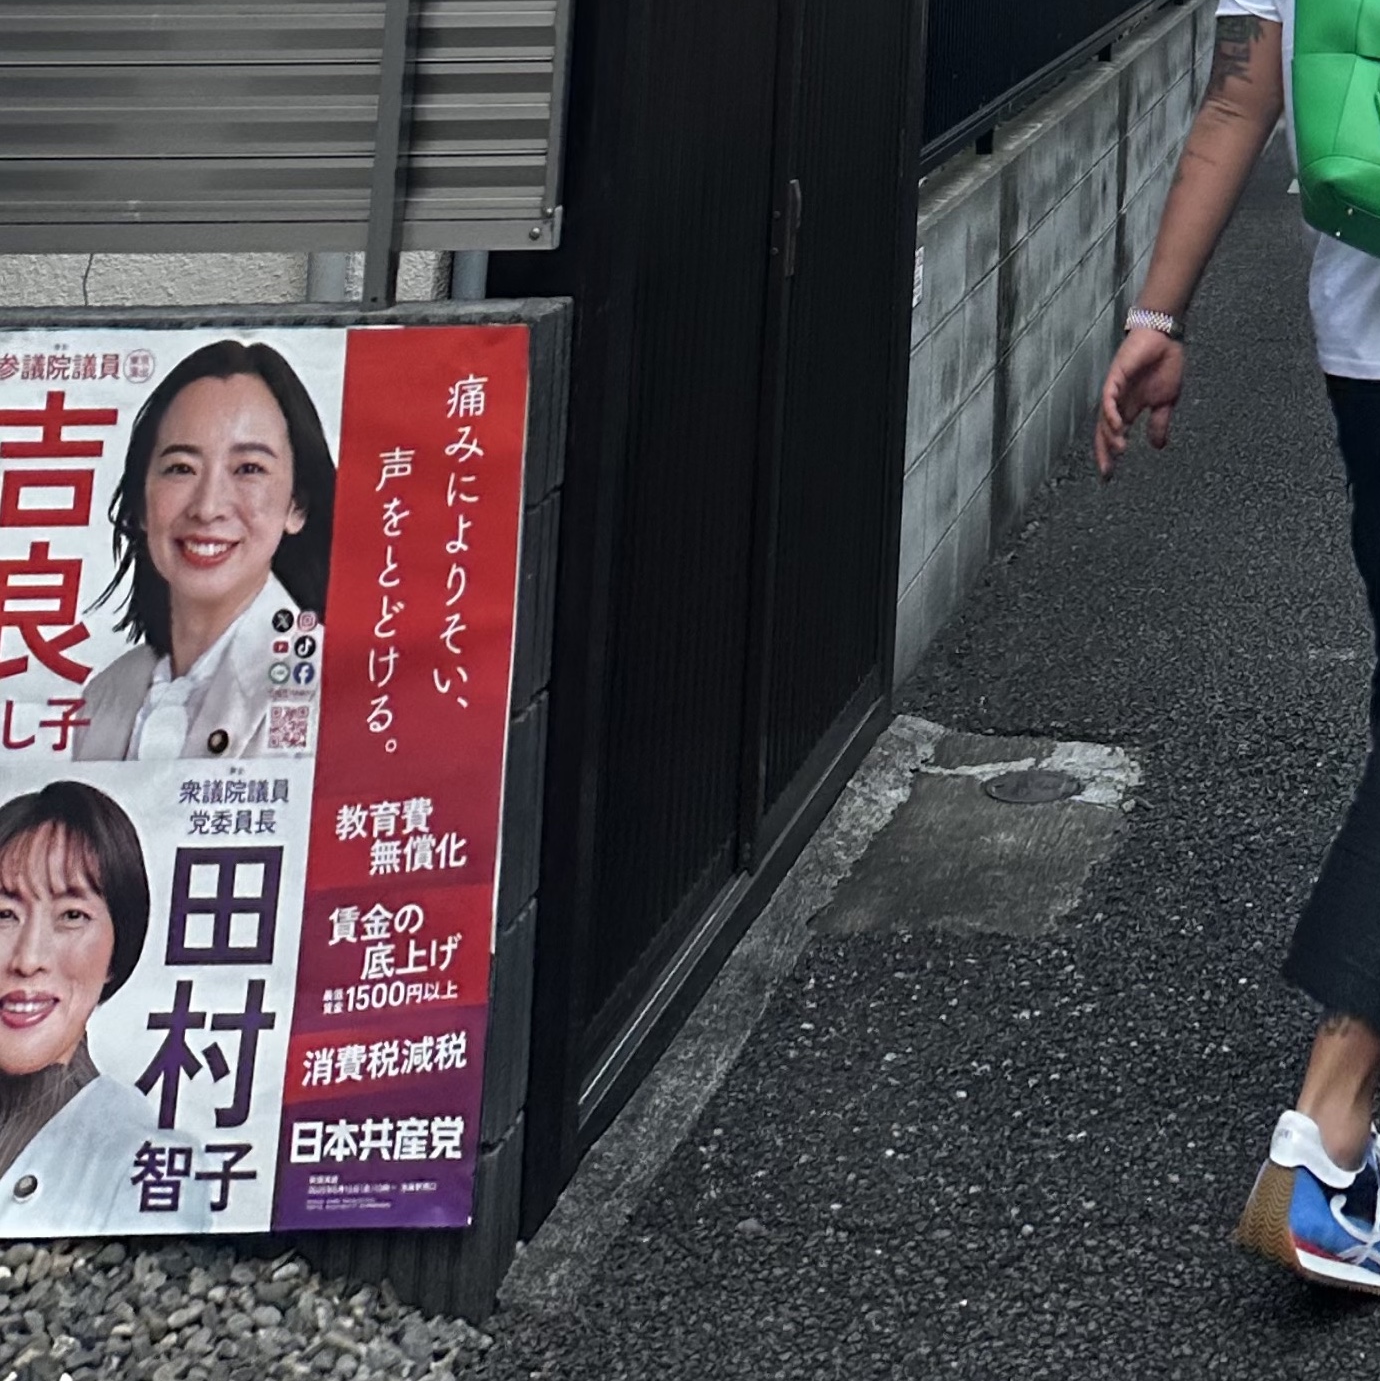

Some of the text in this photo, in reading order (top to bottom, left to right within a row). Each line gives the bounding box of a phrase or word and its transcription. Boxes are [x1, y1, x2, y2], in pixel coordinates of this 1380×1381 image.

[0, 353, 120, 380] 参議院議員
[0, 391, 118, 685] 吉良
[433, 373, 489, 708] 痛みによりそい、
[366, 446, 416, 753] 声をとどける。
[179, 779, 289, 804] 衆議院議員
[188, 809, 276, 835] 党委員長
[335, 797, 433, 841] 教育費
[369, 832, 467, 875] 無償化
[328, 903, 424, 946] 賃金の
[360, 932, 463, 981] 底上げ
[134, 845, 284, 1129] 田村
[346, 980, 458, 1012] 1500円以上
[301, 1031, 468, 1087] 消費税減税
[290, 1116, 465, 1163] 日本共産党
[131, 1141, 257, 1213] 智子
